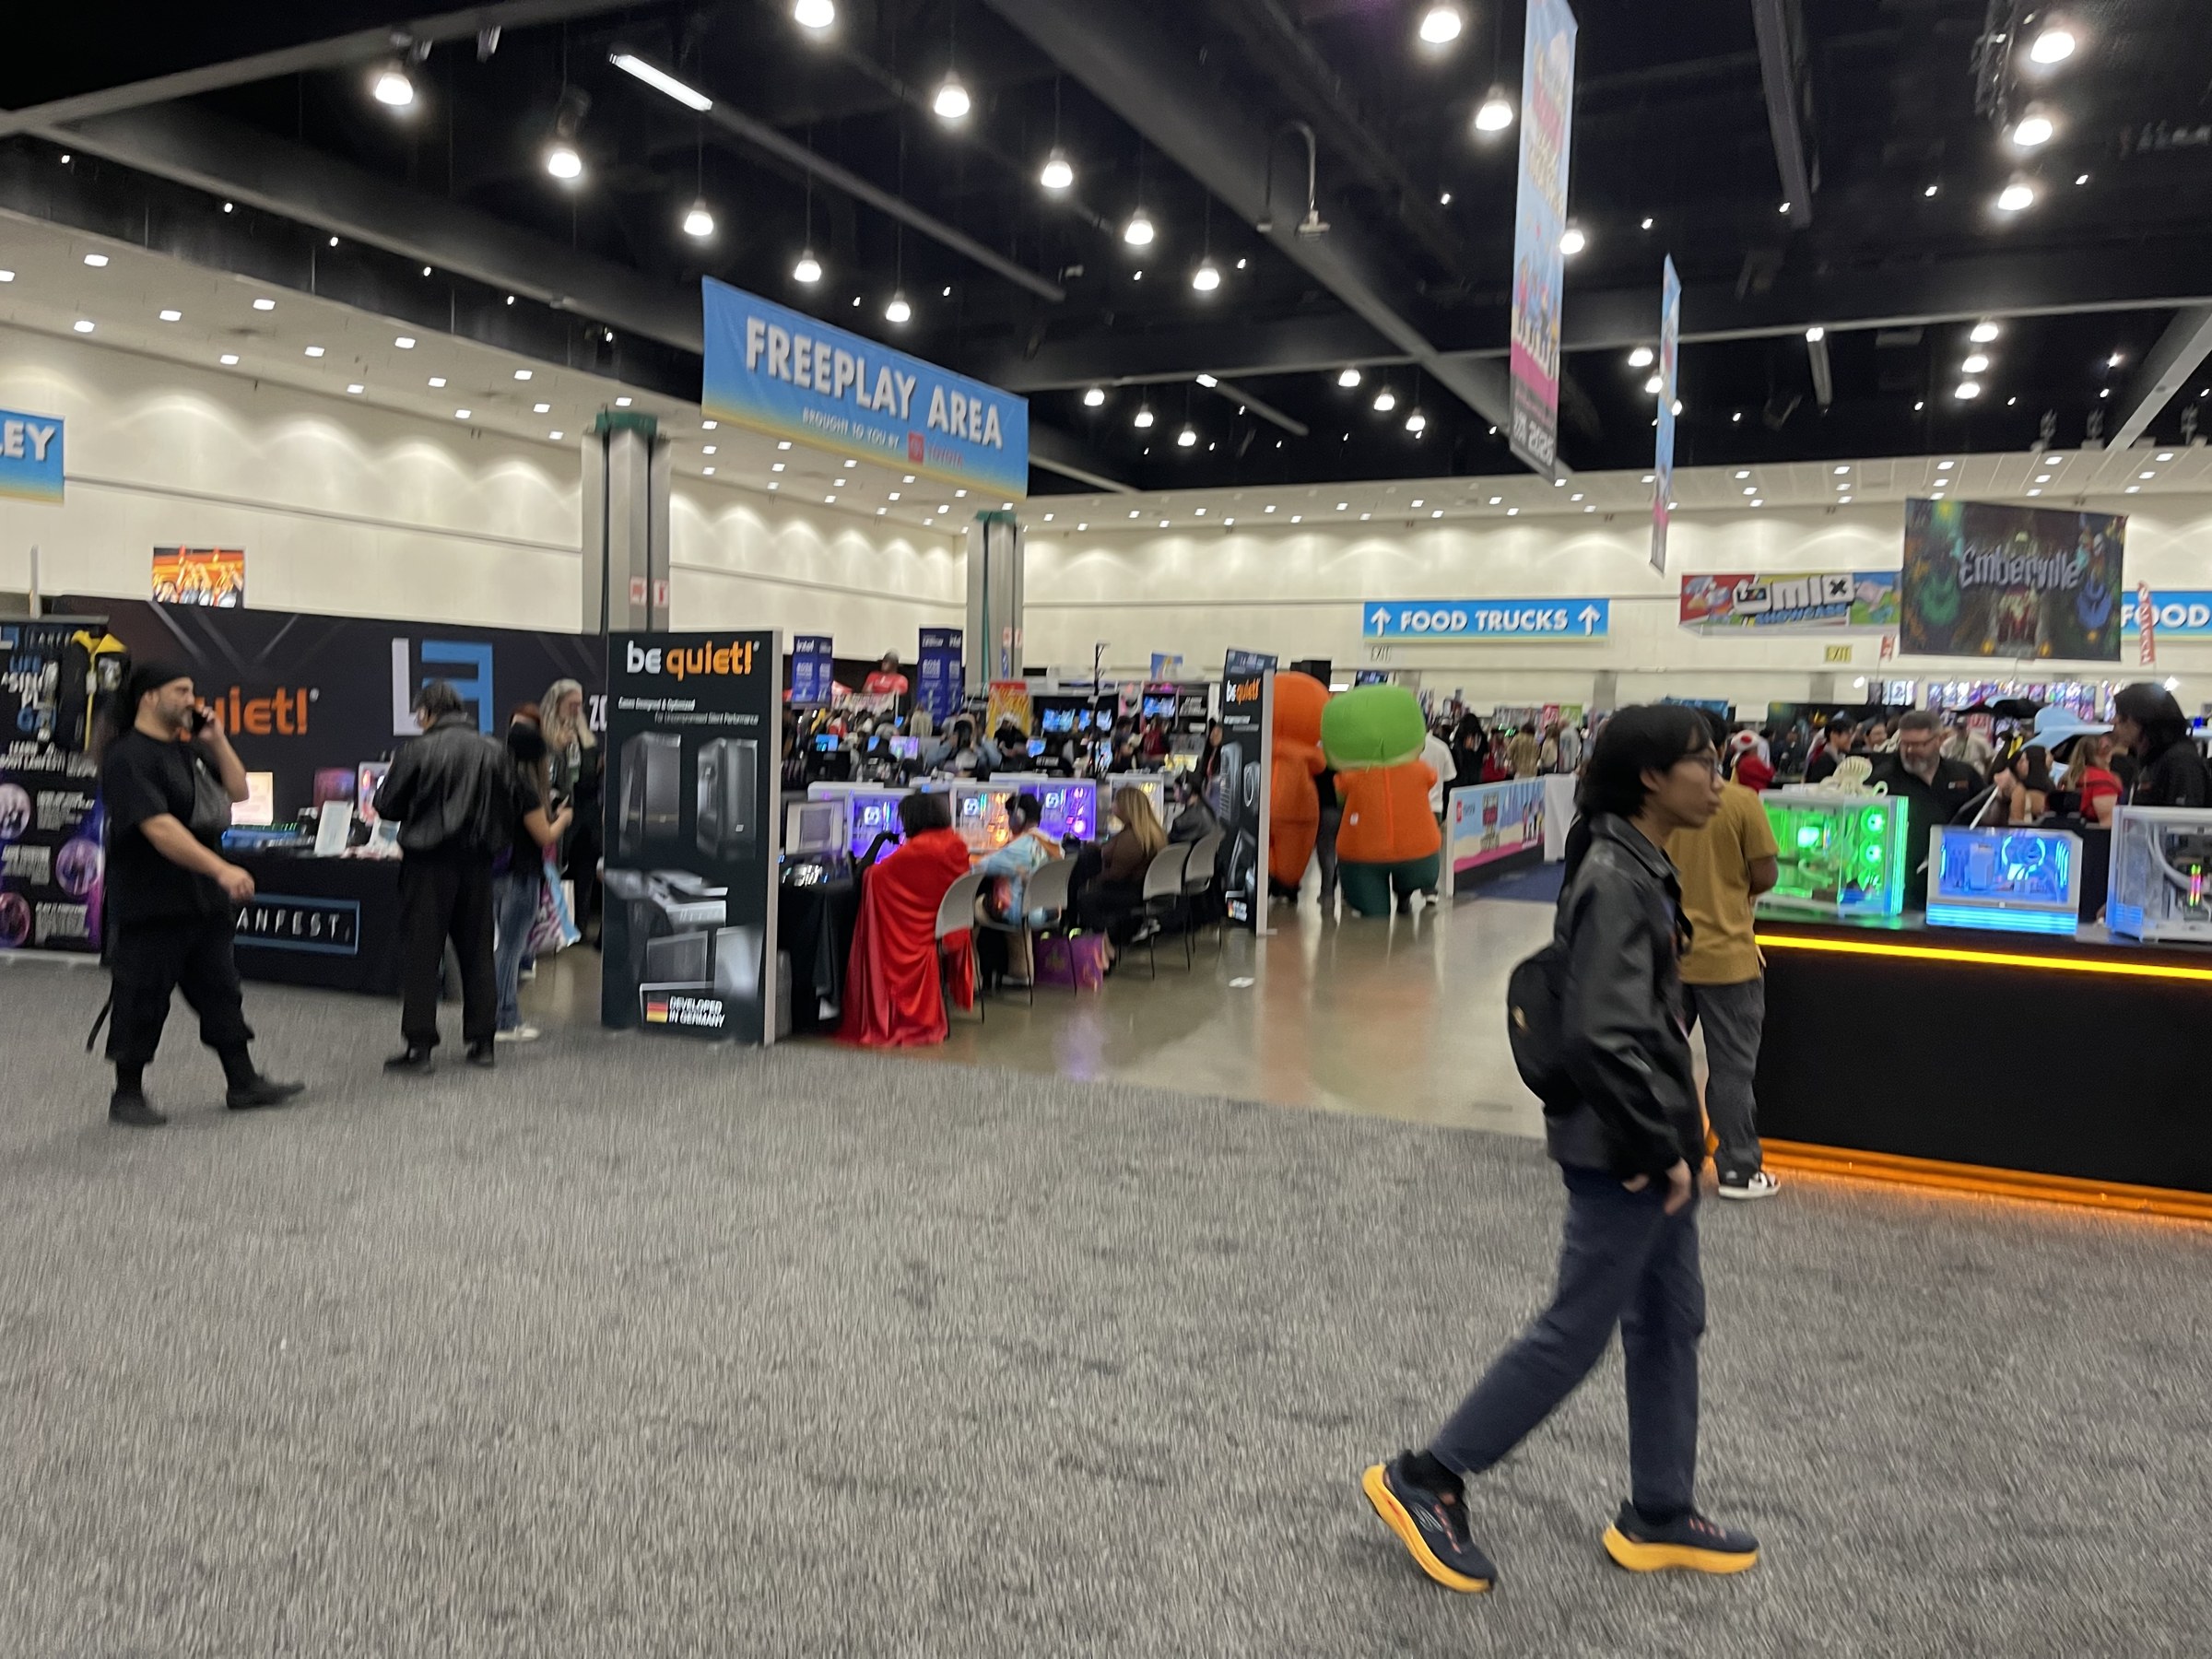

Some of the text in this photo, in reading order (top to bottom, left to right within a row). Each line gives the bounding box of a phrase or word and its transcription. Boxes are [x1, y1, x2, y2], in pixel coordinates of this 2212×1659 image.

[747, 315, 1003, 450] FREEPLAY AREA
[0, 419, 55, 462] EY
[802, 406, 849, 436] BROUGHT
[853, 420, 865, 441] TO
[867, 428, 887, 447] YOU
[1959, 544, 2081, 590] Emberville
[1400, 608, 1569, 632] FOOD TRUCKS
[2121, 604, 2212, 629] FOOD
[627, 640, 662, 675] be
[665, 640, 753, 682] quiet!
[1371, 645, 1392, 663] EXIT
[1226, 680, 1236, 703] be
[180, 687, 309, 743] uiet!
[669, 996, 723, 1015] DEVELOPED
[680, 1011, 725, 1028] GERMANY
